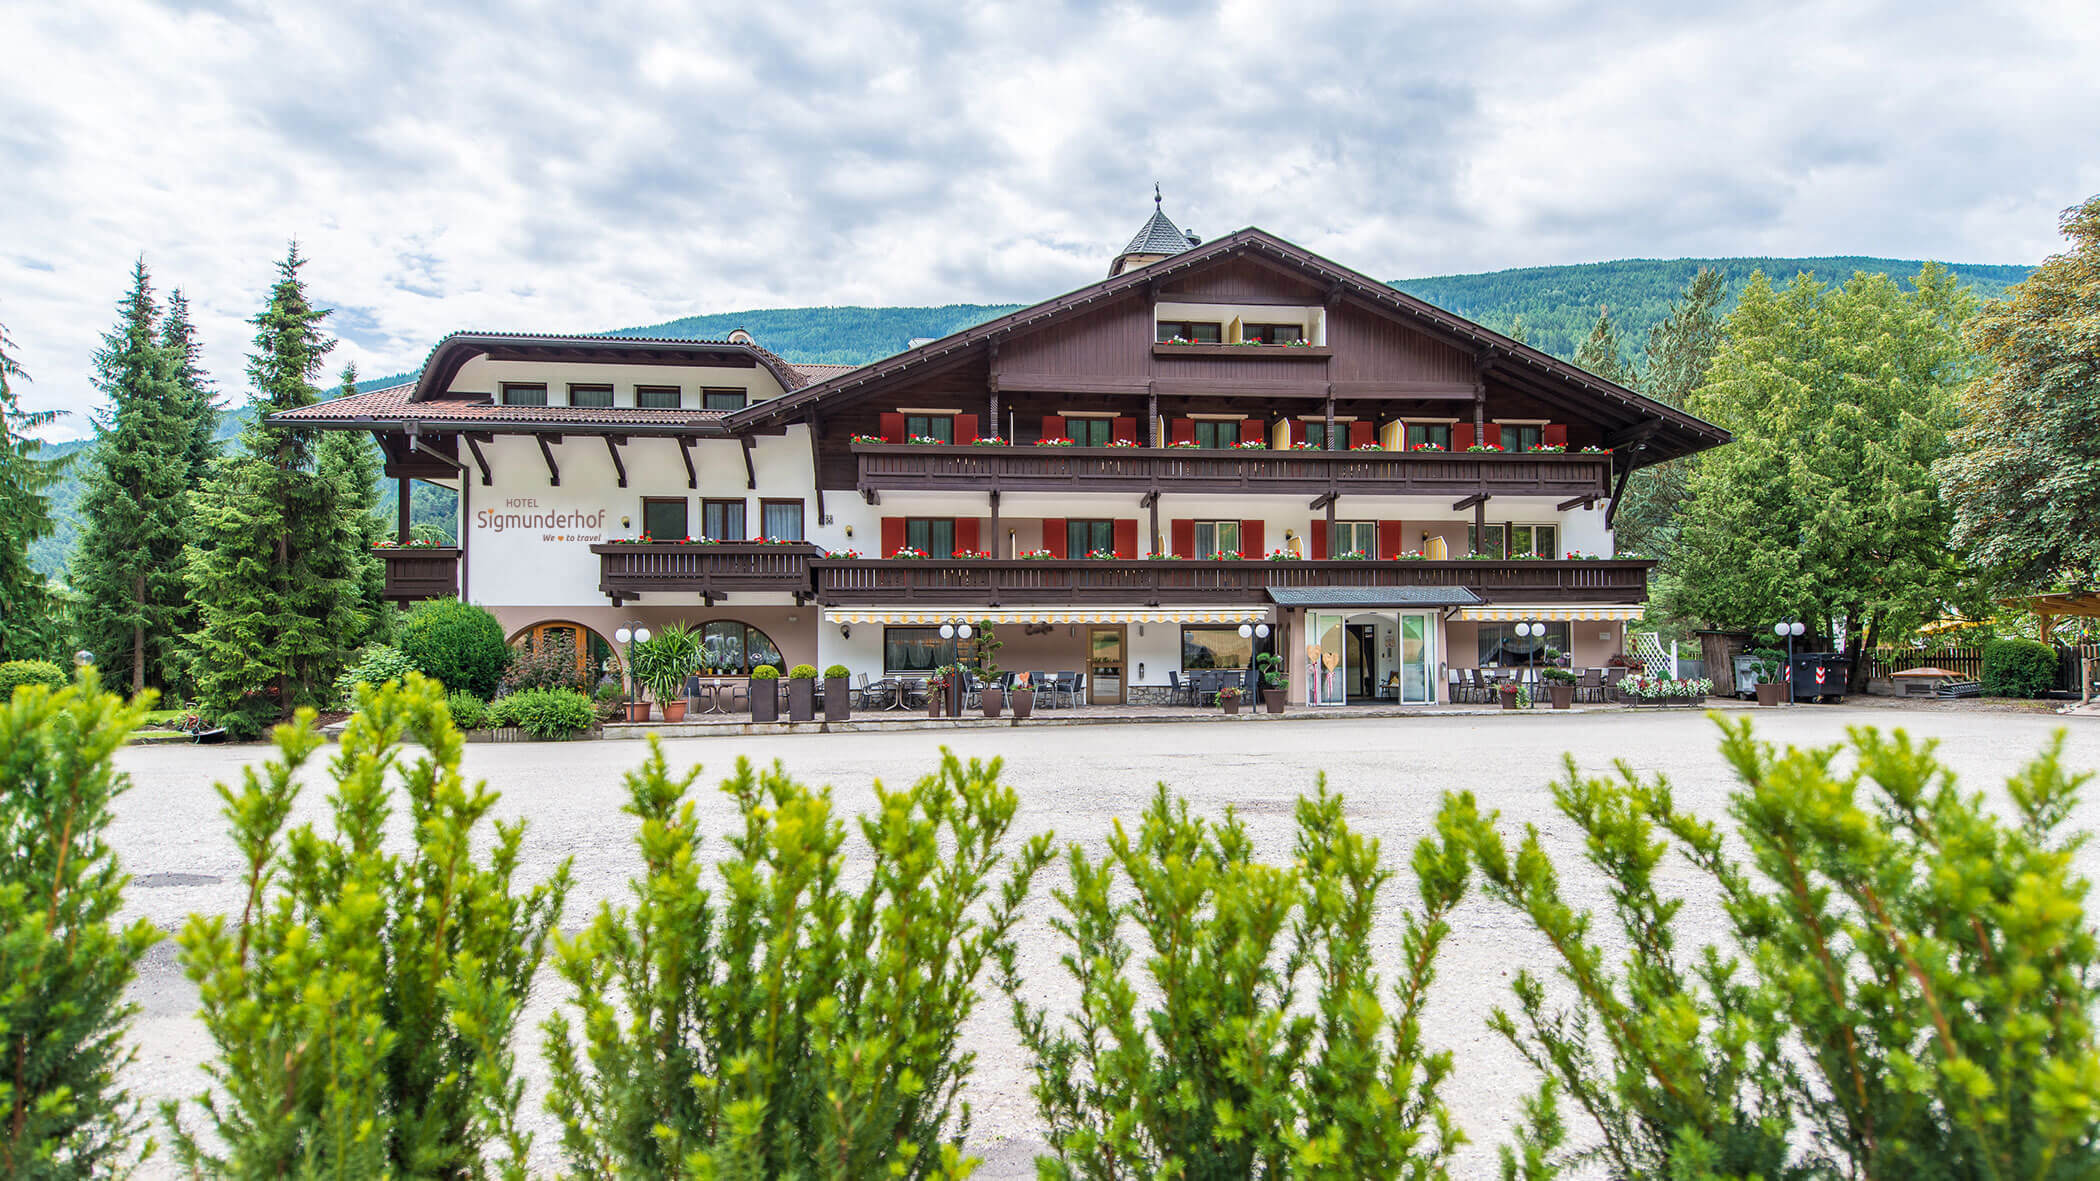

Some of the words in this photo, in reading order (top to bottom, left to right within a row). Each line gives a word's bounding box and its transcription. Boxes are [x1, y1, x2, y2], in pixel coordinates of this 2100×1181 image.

[506, 498, 538, 508] HOTEL
[478, 508, 605, 532] Sigmunderhof
[543, 534, 555, 542] We
[566, 534, 575, 542] to
[577, 534, 601, 542] travel
